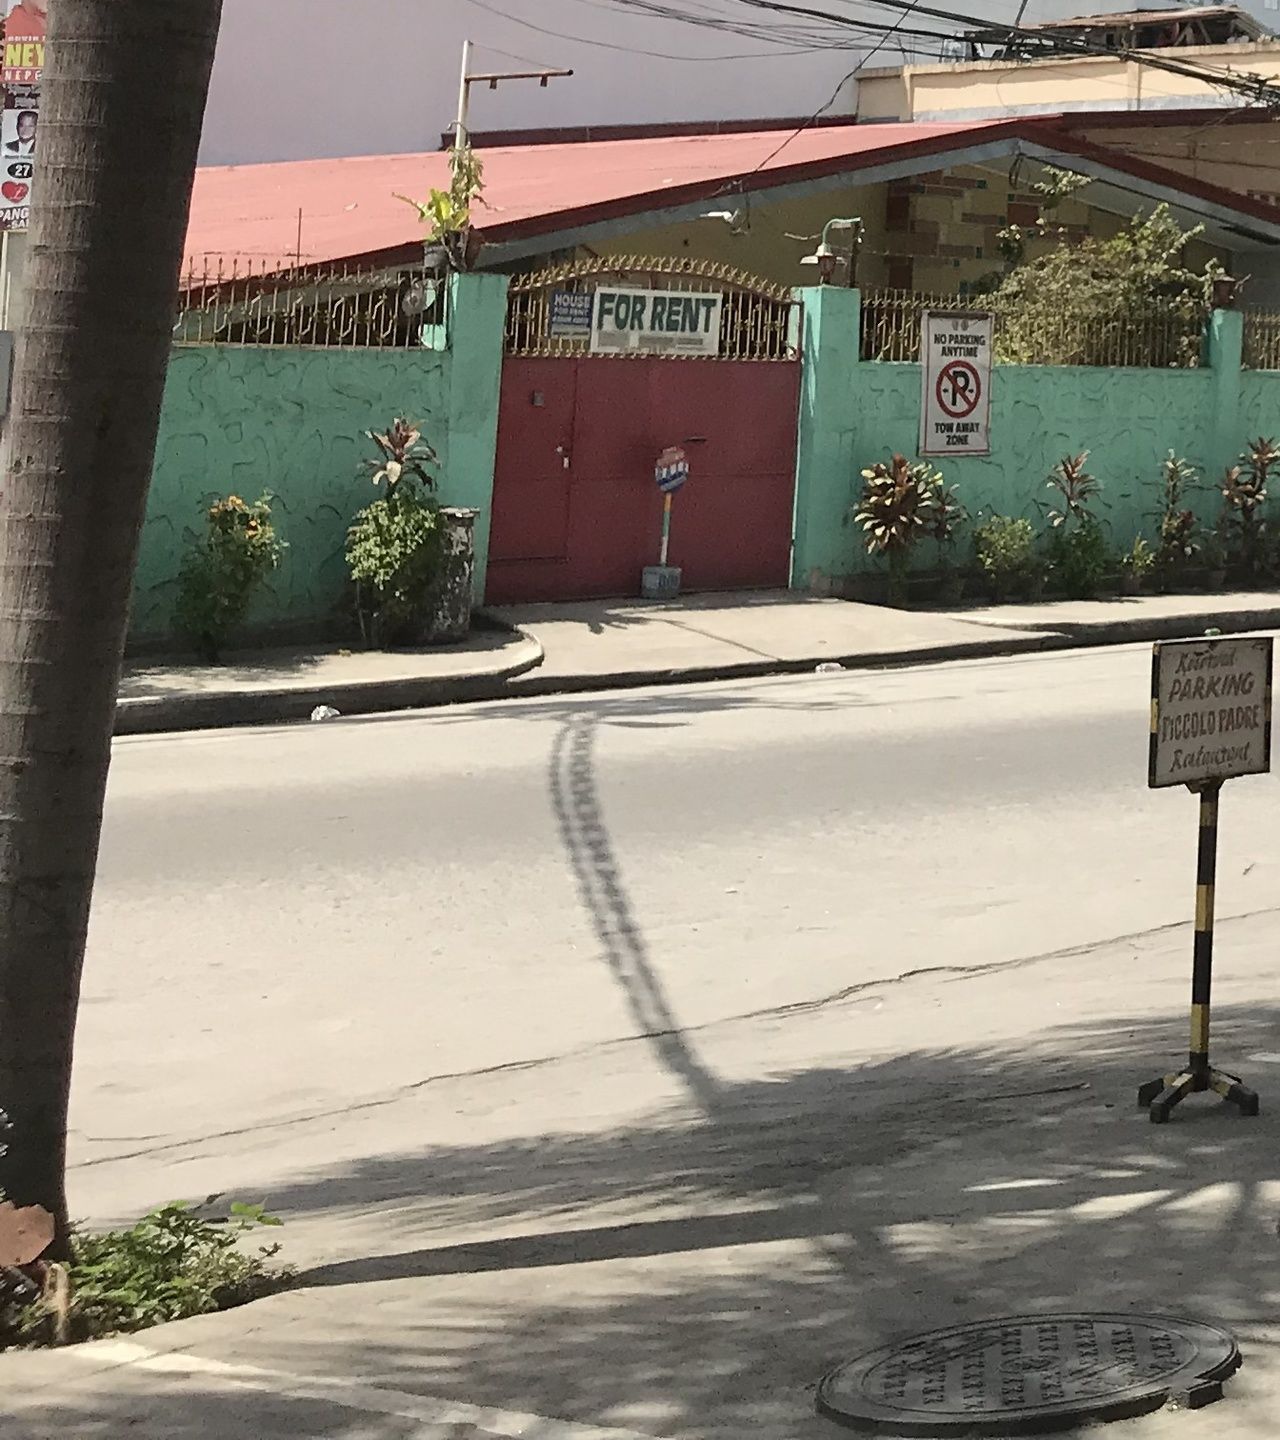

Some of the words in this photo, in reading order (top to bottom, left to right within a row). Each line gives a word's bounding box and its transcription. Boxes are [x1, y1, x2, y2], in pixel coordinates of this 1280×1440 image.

[597, 292, 646, 330] FOR
[650, 296, 717, 333] RENT
[934, 333, 947, 345] NO
[949, 334, 985, 346] PARKING
[941, 346, 978, 358] ANYTIME
[935, 422, 954, 433] TOW
[956, 422, 980, 433] AWAY
[946, 434, 969, 445] ZONE
[1168, 672, 1255, 703] PARKING
